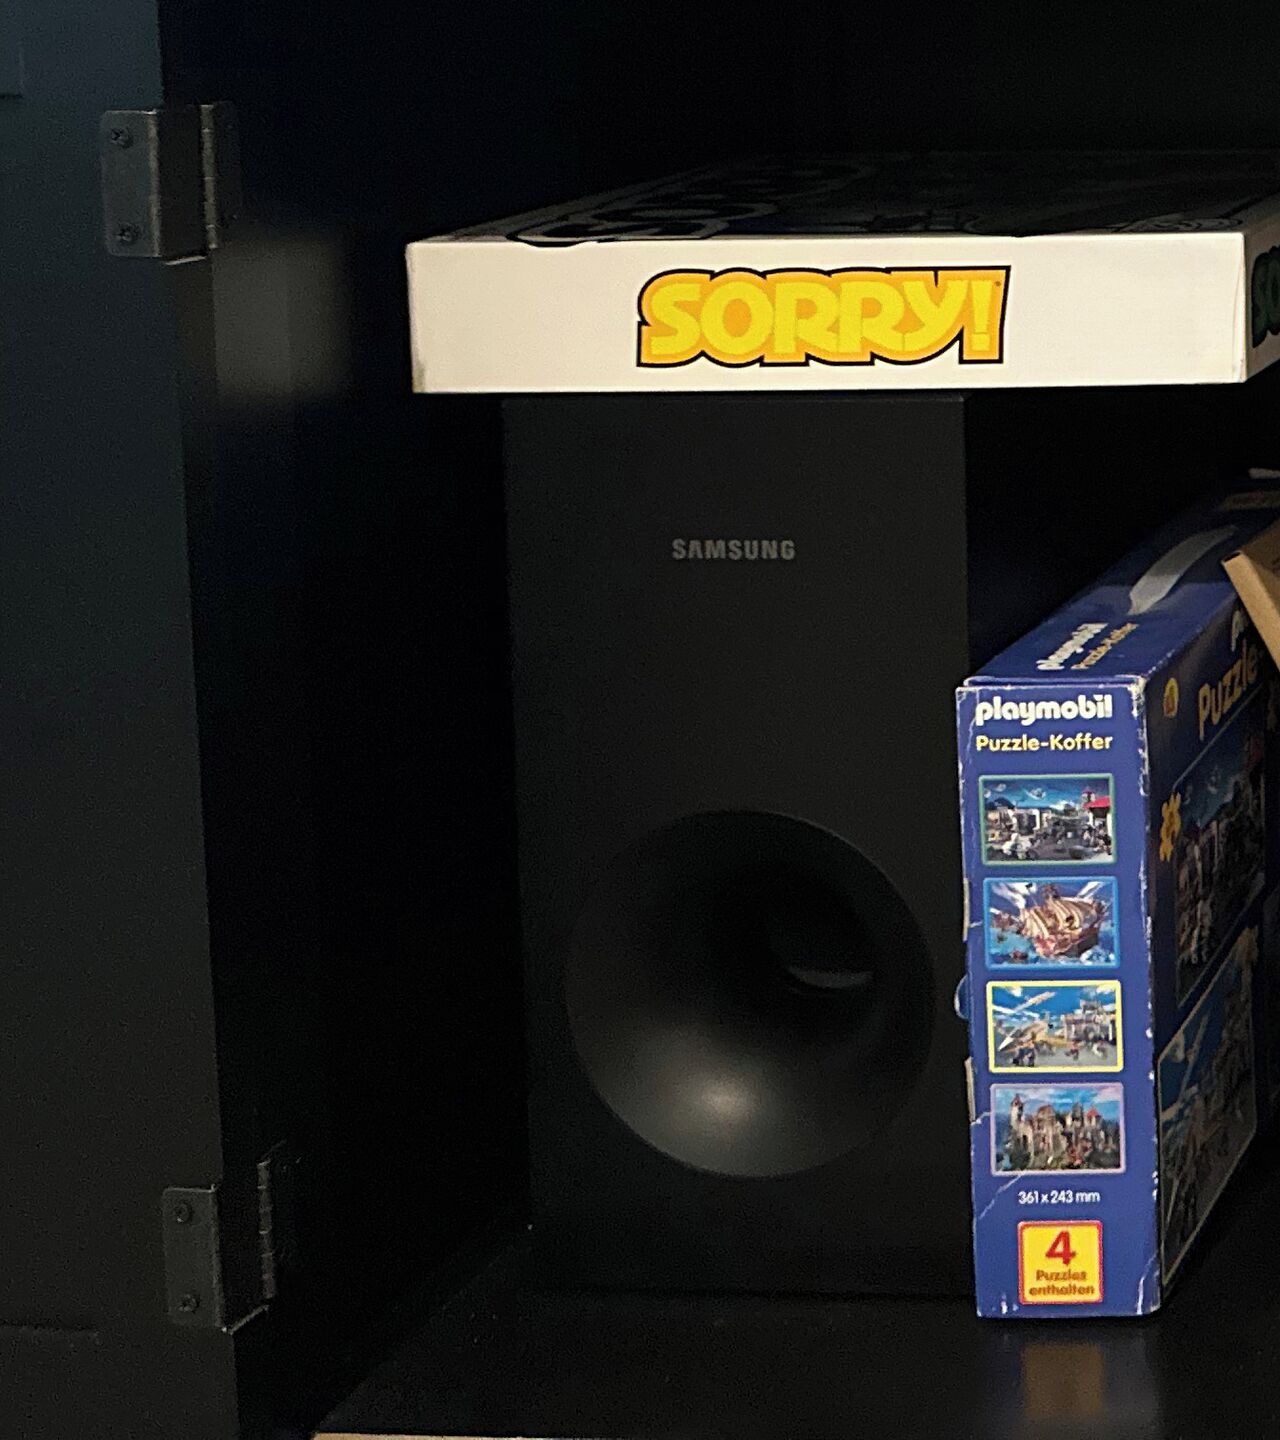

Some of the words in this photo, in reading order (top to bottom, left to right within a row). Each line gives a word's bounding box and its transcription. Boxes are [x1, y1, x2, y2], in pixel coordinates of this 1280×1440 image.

[639, 266, 1009, 366] SORRY!
[670, 539, 796, 561] SAMSUNG
[975, 695, 1113, 727] playmobil
[975, 734, 1113, 752] Puzzle-Koffer
[1045, 1230, 1077, 1265] 4
